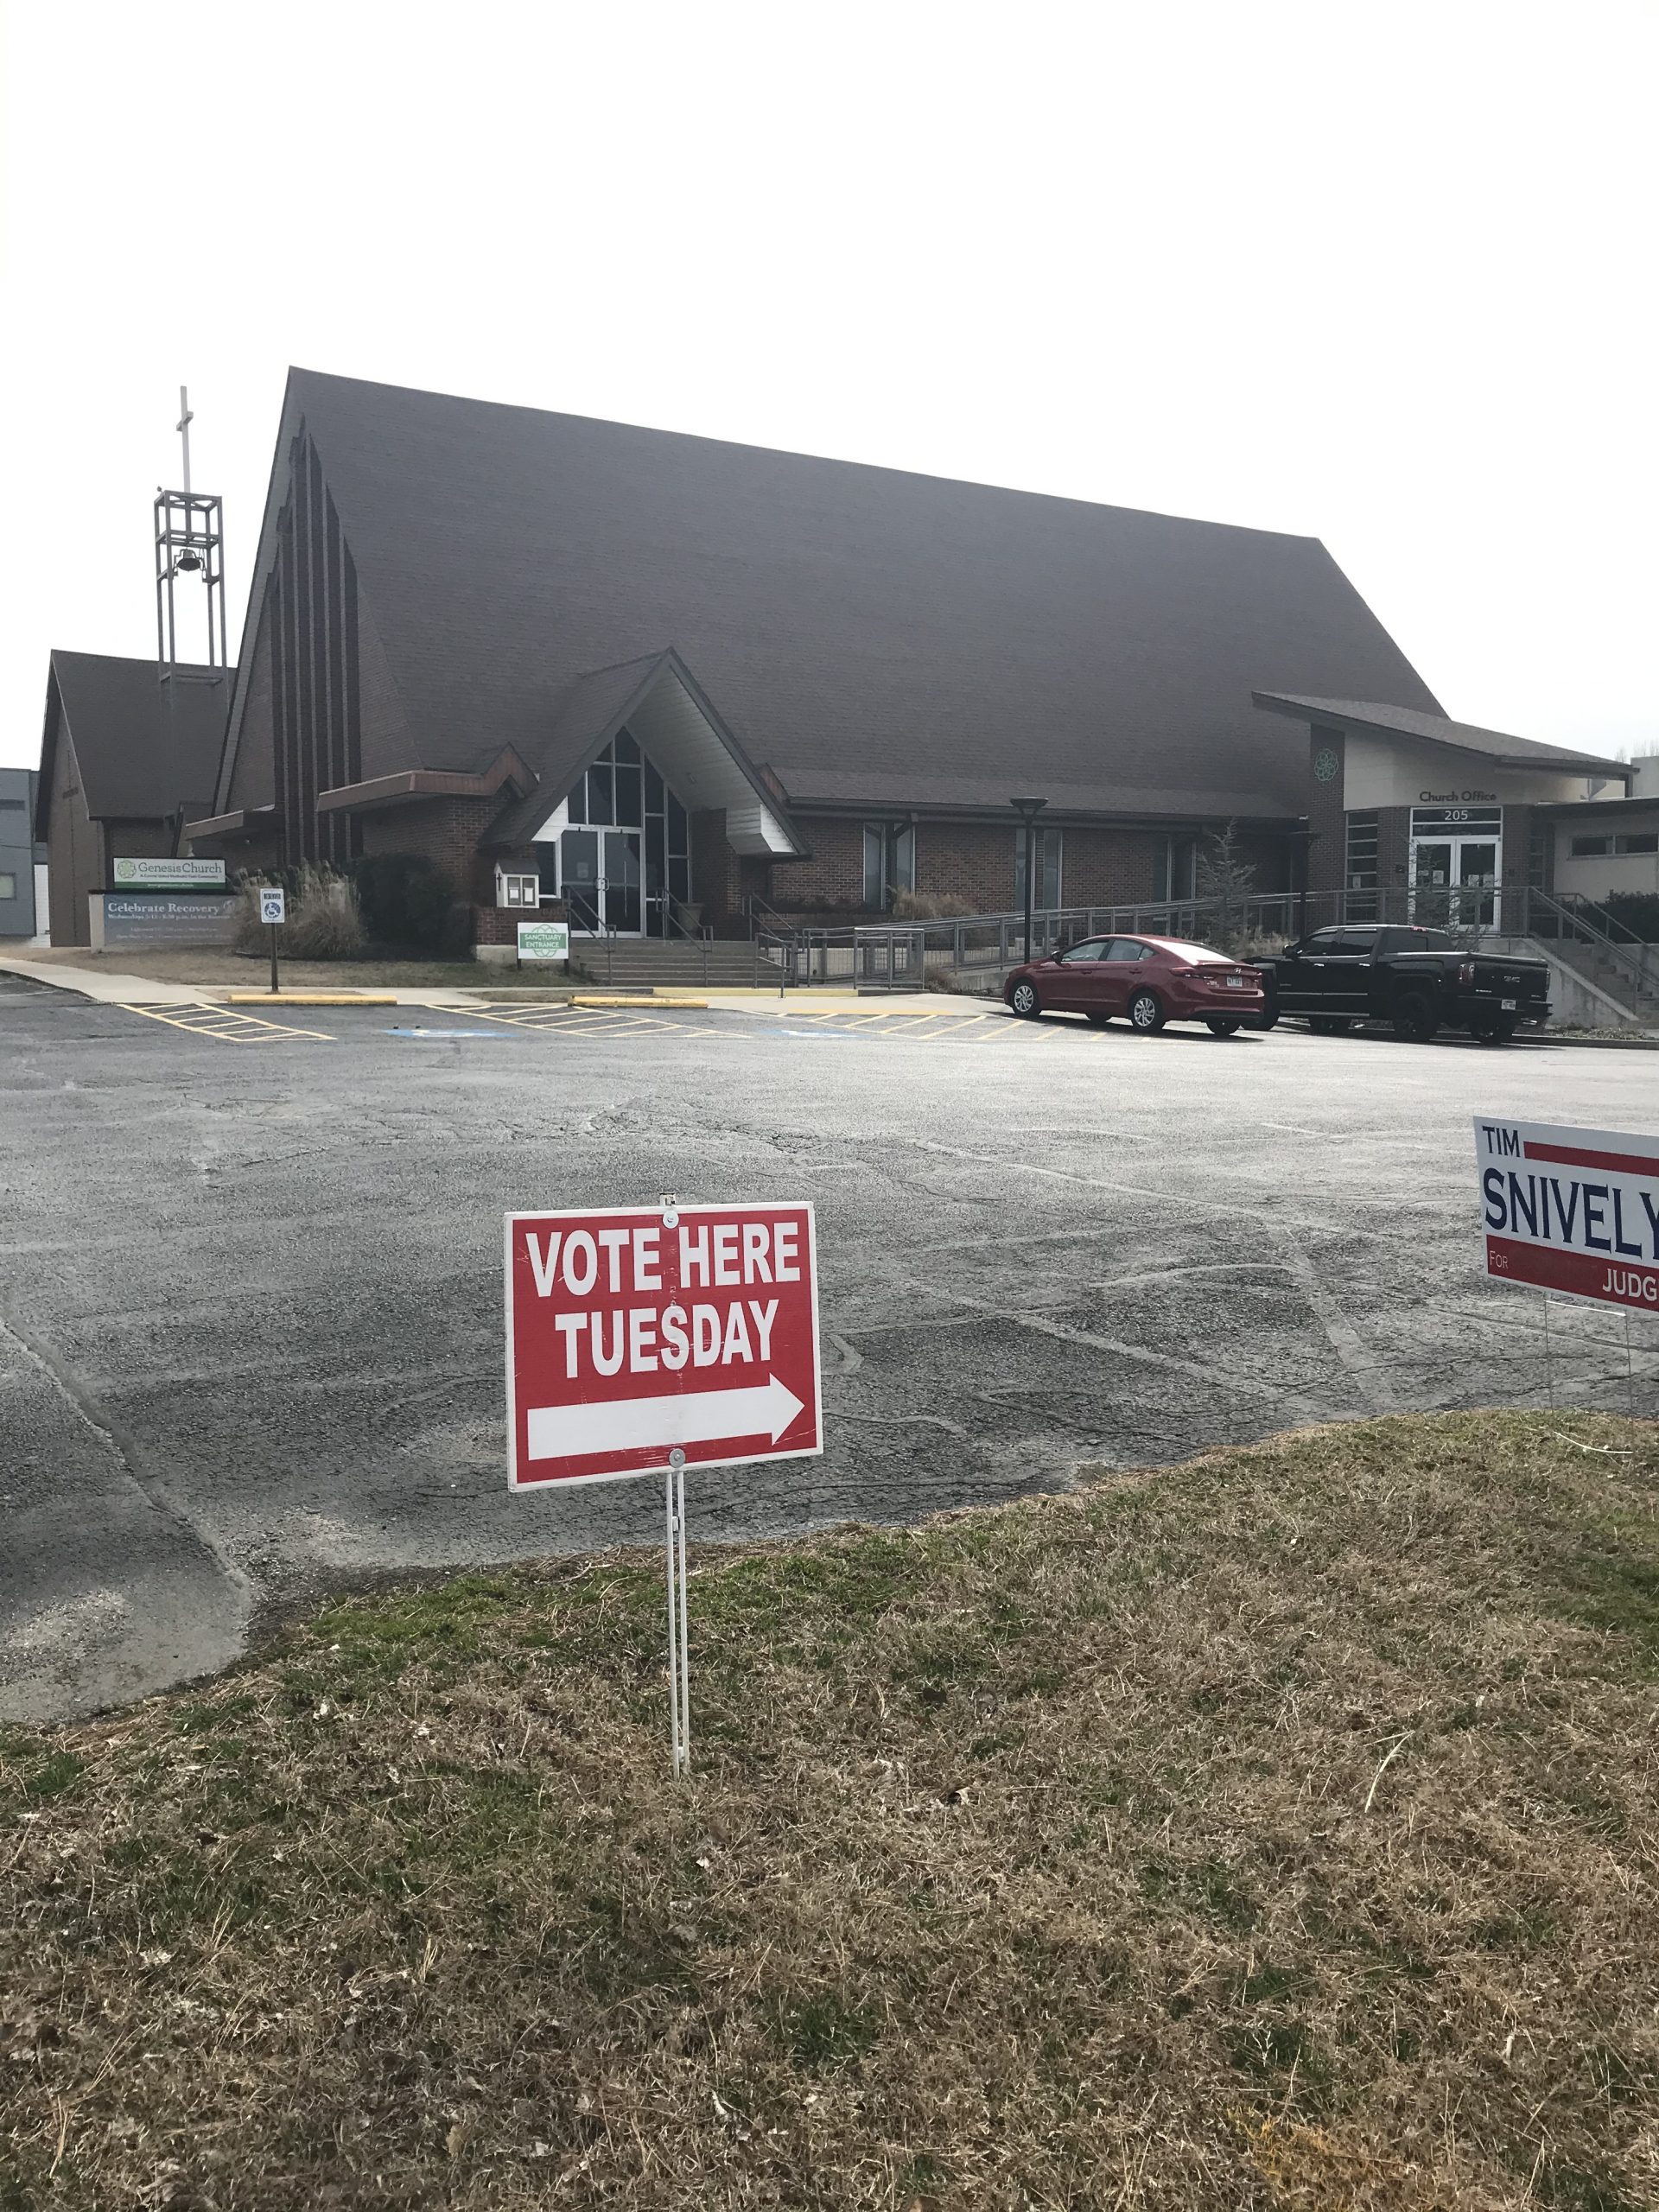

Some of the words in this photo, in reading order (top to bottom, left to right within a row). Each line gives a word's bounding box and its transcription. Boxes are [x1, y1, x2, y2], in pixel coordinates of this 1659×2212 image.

[1420, 791, 1459, 802] Church
[1461, 790, 1497, 802] Office
[1445, 810, 1468, 820] 205
[108, 902, 164, 912] Celebrate
[168, 902, 219, 914] Recovery
[1482, 1126, 1521, 1158] TIM
[525, 1227, 663, 1297] VOTE
[678, 1222, 801, 1288] HERE
[1490, 1250, 1509, 1269] FOR
[555, 1299, 779, 1379] TUESDAY
